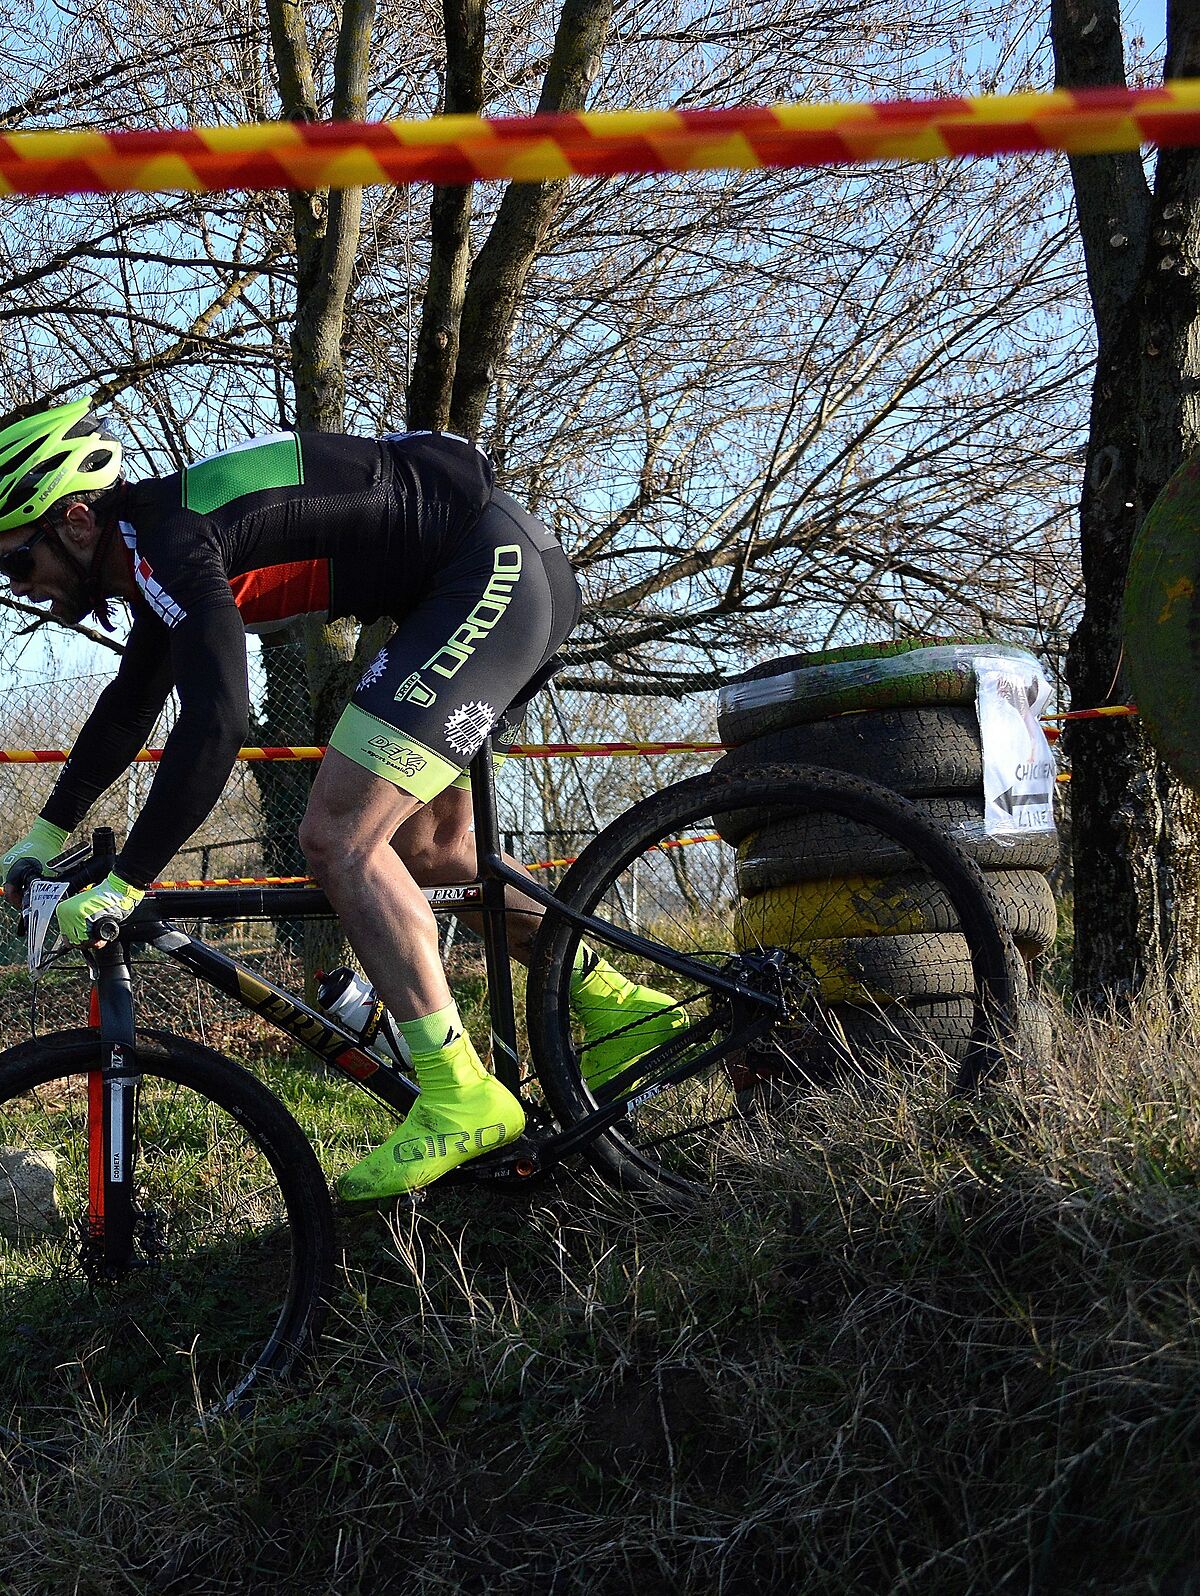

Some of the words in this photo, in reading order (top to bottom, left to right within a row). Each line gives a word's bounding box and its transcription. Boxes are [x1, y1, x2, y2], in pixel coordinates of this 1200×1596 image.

[421, 544, 522, 680] DROMO
[368, 734, 428, 772] DEKA
[1018, 810, 1048, 827] LINE
[432, 888, 467, 900] FRM
[393, 1122, 506, 1164] GIRO
